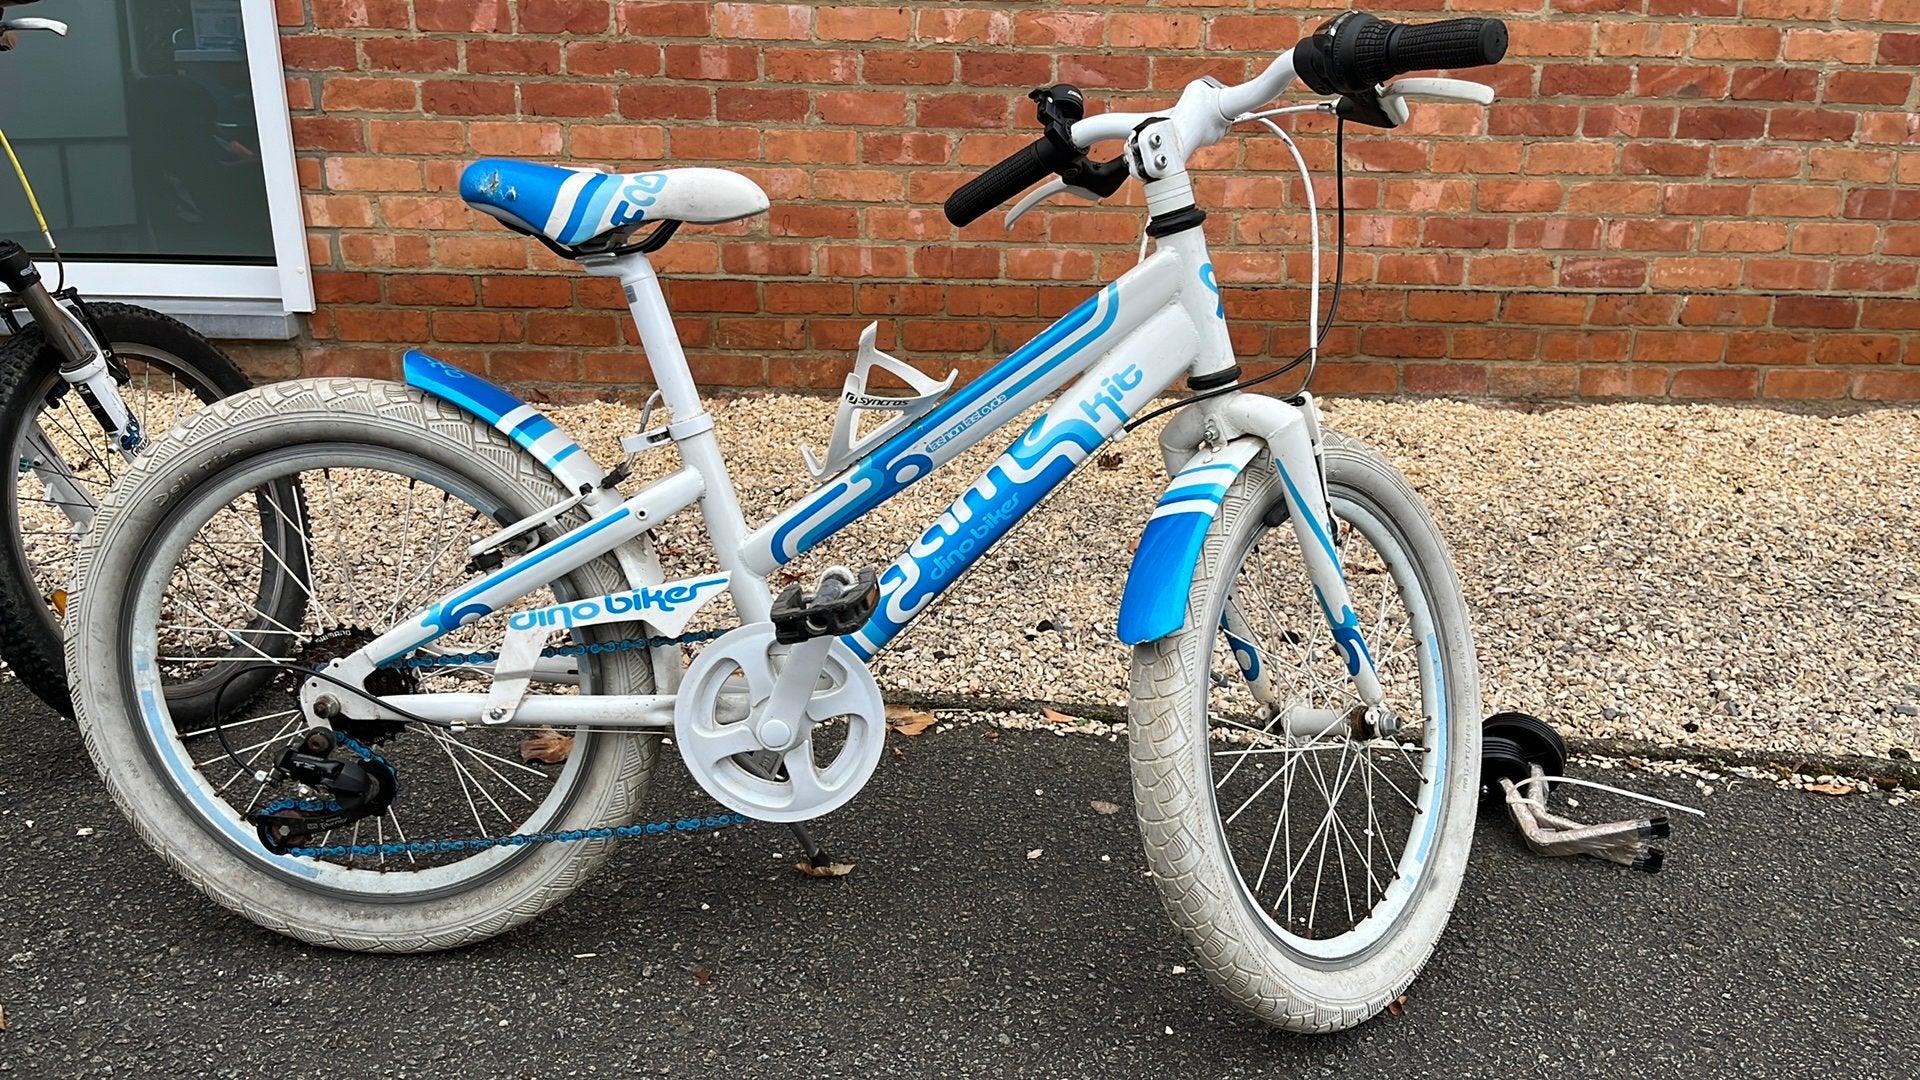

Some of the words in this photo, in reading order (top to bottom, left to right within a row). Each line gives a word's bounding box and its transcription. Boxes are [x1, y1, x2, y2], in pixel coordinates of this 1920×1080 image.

[1079, 363, 1144, 425] kit
[930, 538, 975, 581] dino
[508, 601, 601, 630] dino
